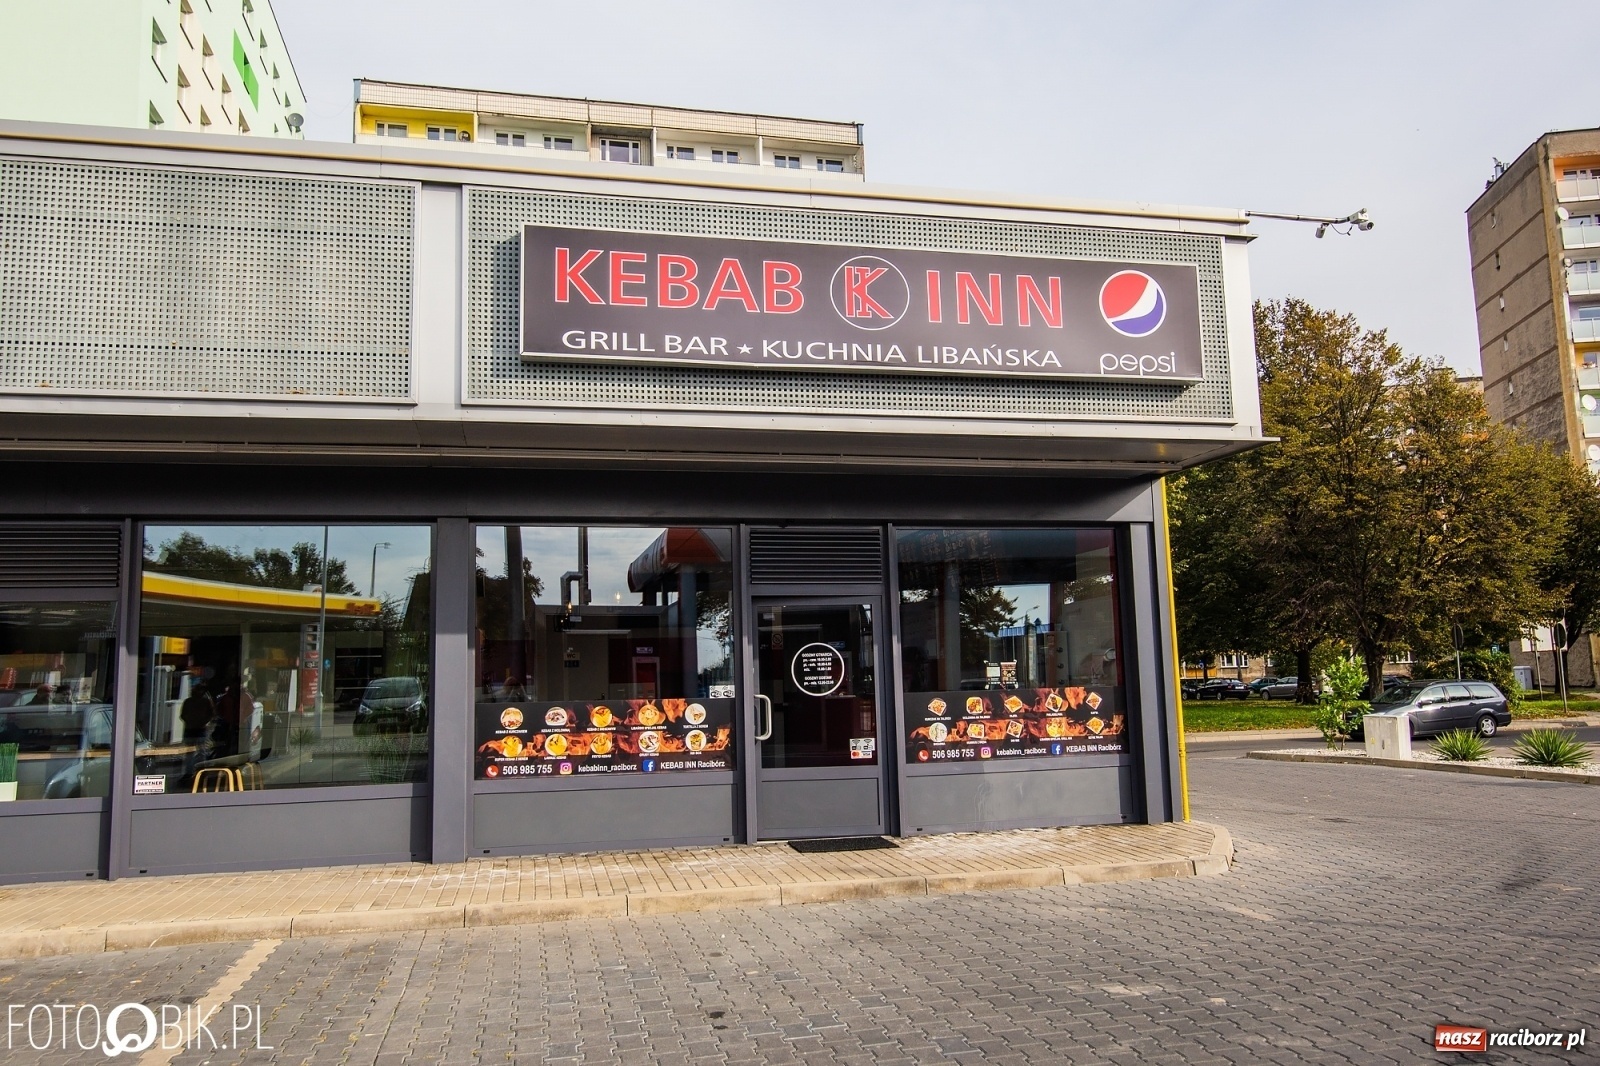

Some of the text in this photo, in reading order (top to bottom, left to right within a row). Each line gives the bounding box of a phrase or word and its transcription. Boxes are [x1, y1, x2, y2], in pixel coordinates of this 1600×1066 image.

[554, 247, 805, 315] KEBAB
[926, 269, 1064, 329] INN
[561, 329, 1063, 368] GRILL BAR KUCHNIA LIBAŃSKA
[1099, 351, 1177, 376] pepsi
[996, 747, 1047, 756] kebabinn_raciborz
[1066, 745, 1086, 753] KEBAB
[1087, 744, 1098, 752] INN
[932, 749, 975, 759] 506 985 755
[502, 764, 553, 775] 506 985 755
[578, 763, 637, 773] kebabinn_raciborz
[660, 760, 726, 769] KEBAB INN Racibórz
